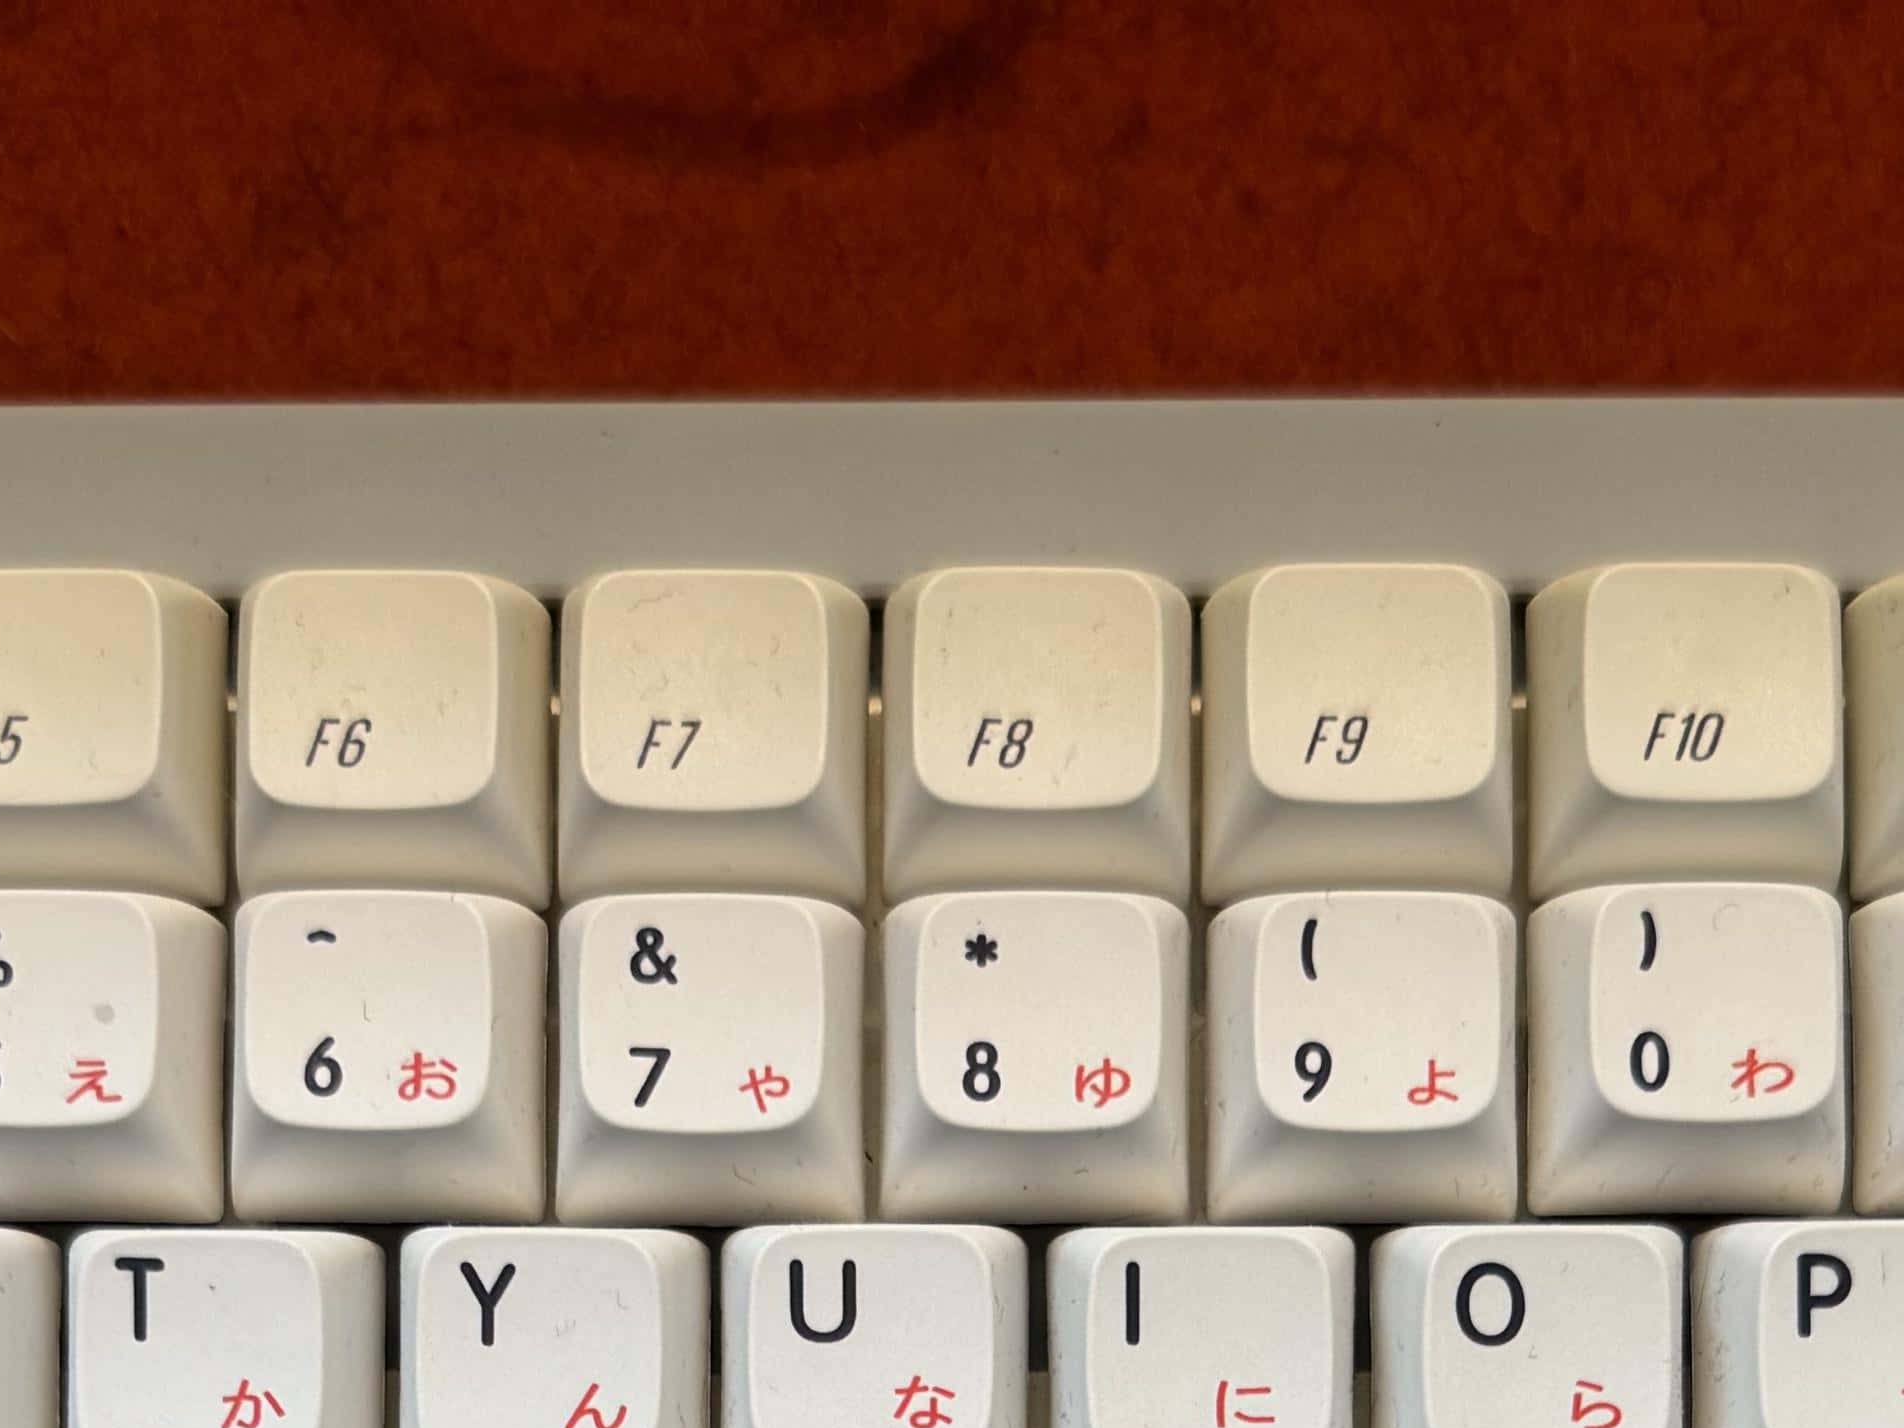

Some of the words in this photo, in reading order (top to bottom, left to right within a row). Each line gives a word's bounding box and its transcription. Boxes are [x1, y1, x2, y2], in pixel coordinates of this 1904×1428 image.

[304, 716, 373, 769] F6
[635, 717, 703, 771] F7
[966, 716, 1035, 770] F8
[1303, 714, 1370, 766] F9
[1642, 710, 1726, 763] F10
[628, 925, 679, 986] &
[1299, 916, 1319, 982] (
[1638, 909, 1659, 972] )
[64, 1057, 122, 1105] え
[302, 1035, 344, 1098] 6
[396, 1049, 458, 1102] お
[627, 1045, 673, 1109] 7
[738, 1063, 793, 1114] や
[960, 1039, 1003, 1103] 8
[1073, 1055, 1133, 1108] ゆ
[1293, 1039, 1334, 1104] 9
[1406, 1057, 1458, 1107] よ
[1628, 1029, 1672, 1093] 0
[1731, 1046, 1797, 1098] わ
[113, 1255, 166, 1343] T
[458, 1260, 518, 1348] Y
[787, 1257, 858, 1345] U
[1124, 1259, 1142, 1347] I
[1454, 1260, 1527, 1348] O
[1795, 1251, 1854, 1339] P
